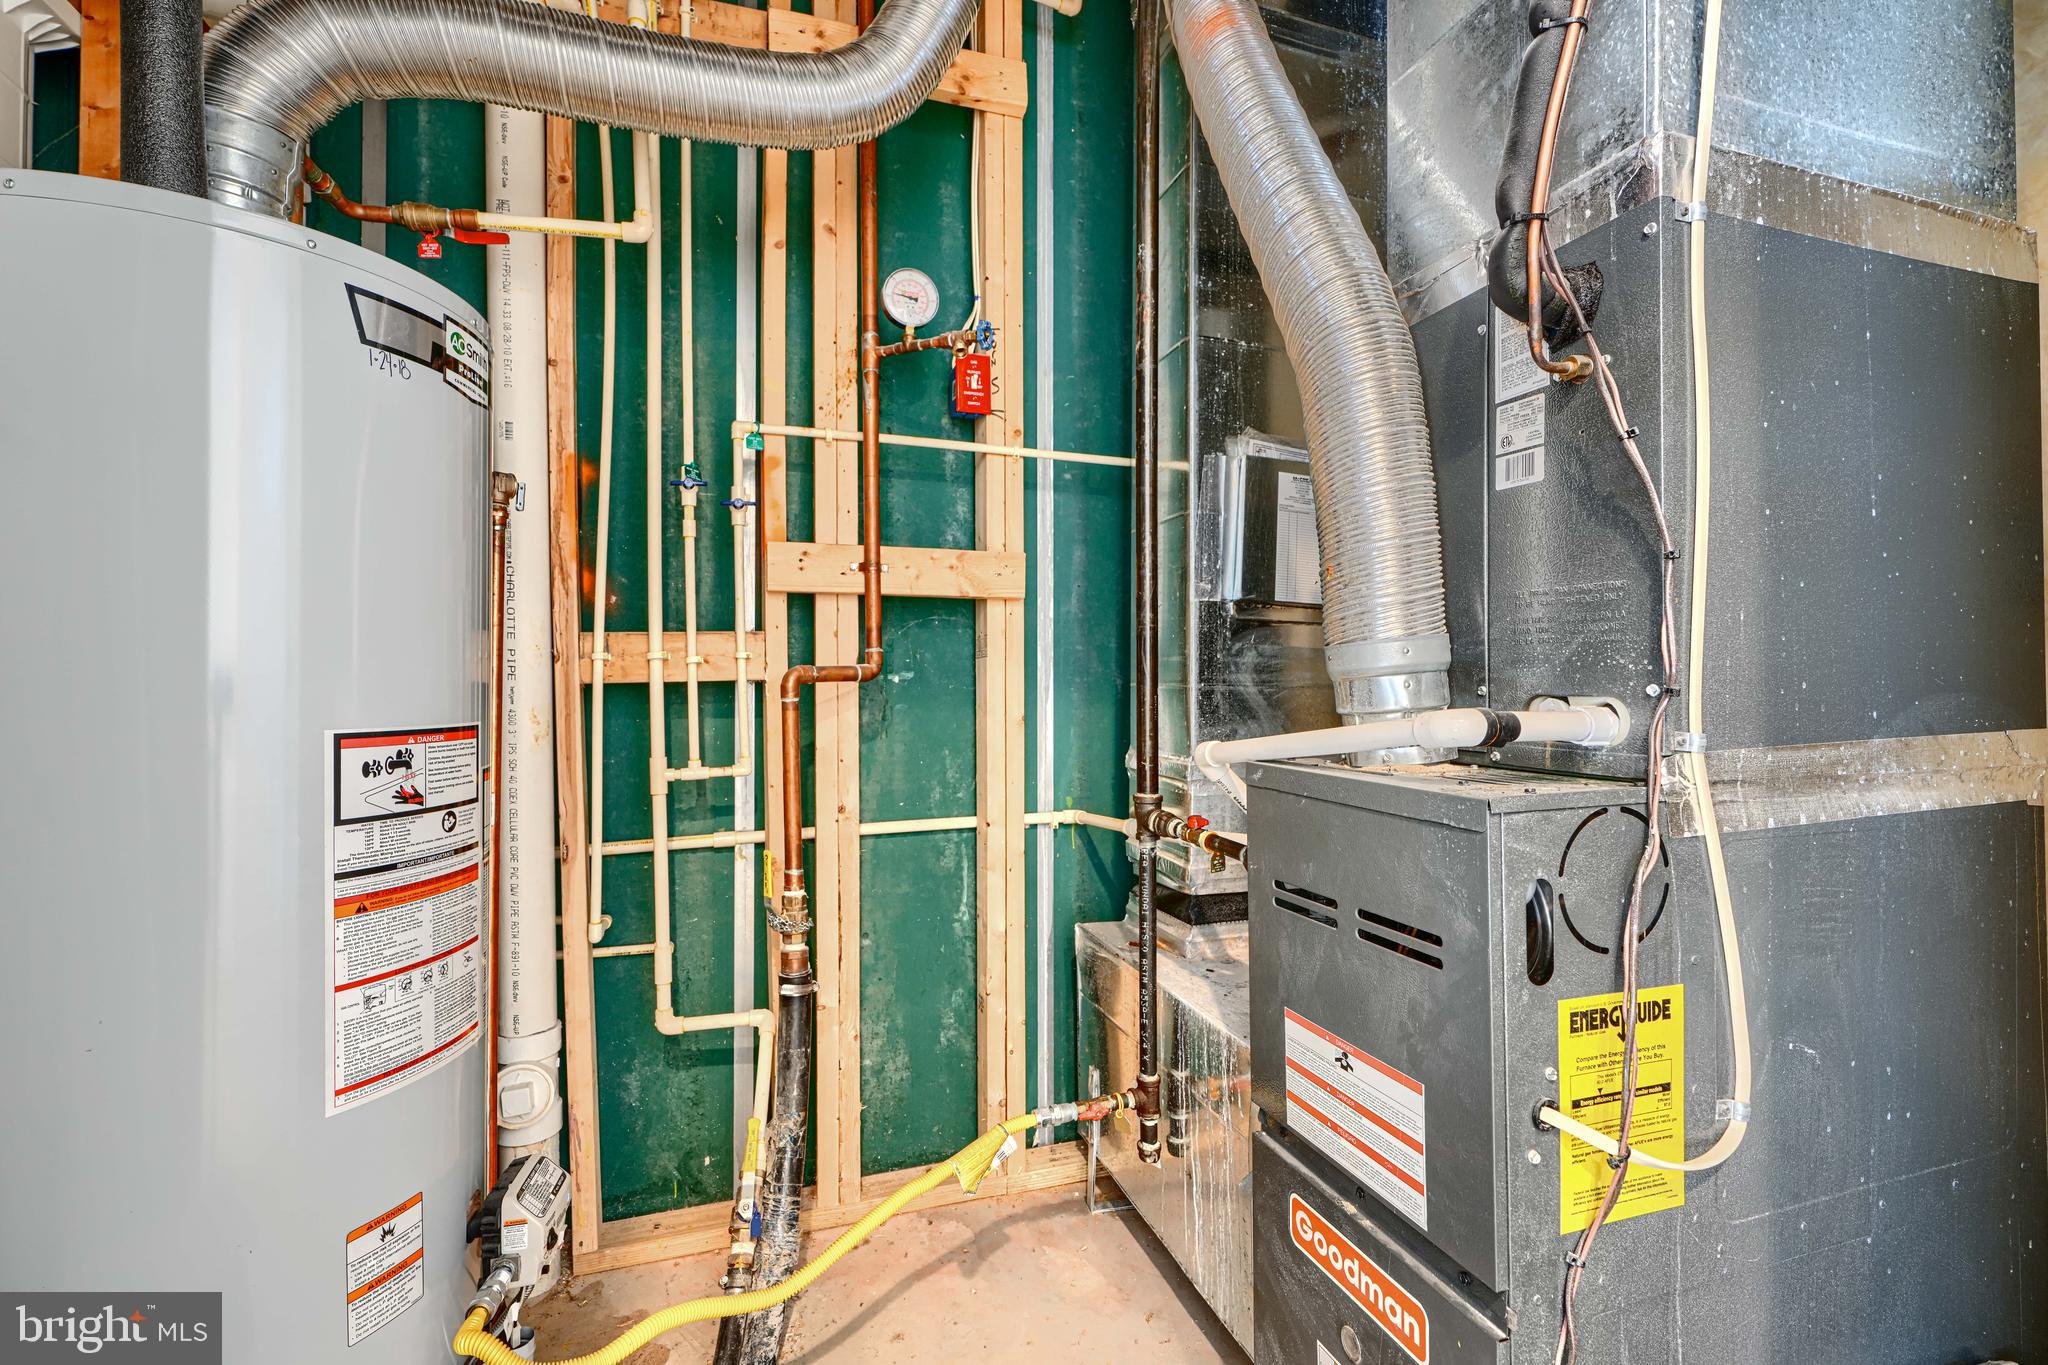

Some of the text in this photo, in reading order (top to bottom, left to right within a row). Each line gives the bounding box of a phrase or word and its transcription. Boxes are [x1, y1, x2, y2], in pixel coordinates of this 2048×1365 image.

[503, 322, 512, 355] 08/28/10
[466, 343, 487, 373] Smith
[506, 566, 516, 640] CHARLOTTE
[507, 649, 516, 681] PIPE
[508, 709, 516, 726] 4300
[417, 734, 445, 744] DANGER
[508, 743, 517, 755] IPS
[509, 759, 517, 771] SCH
[509, 775, 517, 784] 40
[509, 808, 518, 842] CELLULAR
[353, 853, 379, 861] Thermostatic
[509, 846, 519, 863] CORE
[510, 867, 519, 880] PVC
[510, 883, 519, 897] DWV
[1140, 872, 1150, 915] HYUNDAI
[510, 900, 519, 917] PIPE
[511, 921, 520, 939] ASTM
[1140, 958, 1150, 984] ASTM
[1335, 1037, 1355, 1055] DANGER
[1576, 1054, 1598, 1064] Compare
[1599, 1052, 1607, 1060] the
[1609, 1049, 1624, 1058] Energy
[1576, 1063, 1596, 1072] Furnace
[1336, 1091, 1356, 1108] DANGER
[1581, 1098, 1594, 1107] Energy
[1337, 1126, 1357, 1145] PELIGRO
[374, 1203, 407, 1226] WARNING
[374, 1260, 408, 1287] WARNING
[1295, 1210, 1422, 1347] Goodman
